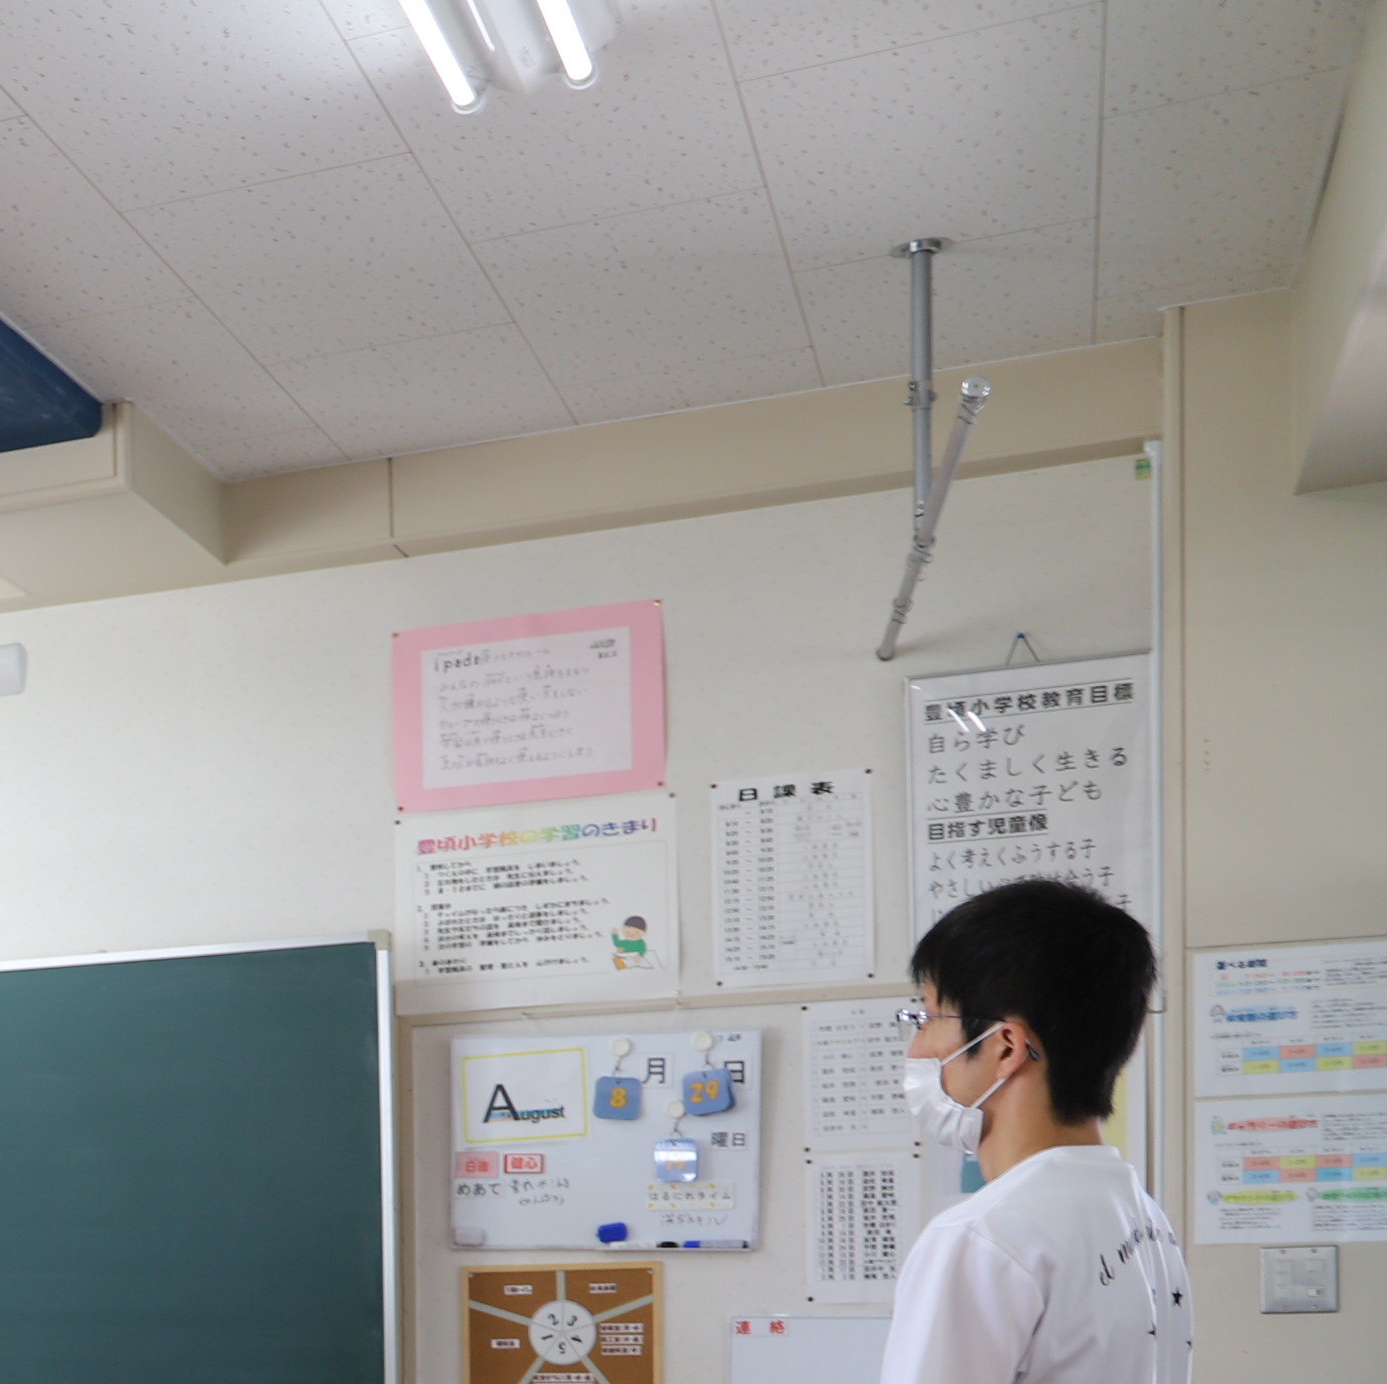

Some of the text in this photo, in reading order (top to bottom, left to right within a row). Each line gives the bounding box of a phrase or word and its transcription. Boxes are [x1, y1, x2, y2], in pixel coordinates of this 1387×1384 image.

[928, 724, 1026, 754] 自ら学び
[928, 747, 1128, 784] たくましく生きる
[928, 780, 1103, 814] 心豊かな子ども
[415, 818, 658, 855] 豊頃小学校の学習のきまり
[928, 813, 1048, 841] 目指す児童像
[929, 838, 1097, 872] よく考えくふうする子
[642, 1057, 745, 1085] 月 日
[483, 1083, 566, 1124] August
[609, 1080, 720, 1109] 8 29
[711, 1131, 746, 1148] 曜日
[456, 1183, 501, 1197] めあて
[547, 1313, 578, 1327] 2 3
[736, 1319, 785, 1335] 連絡
